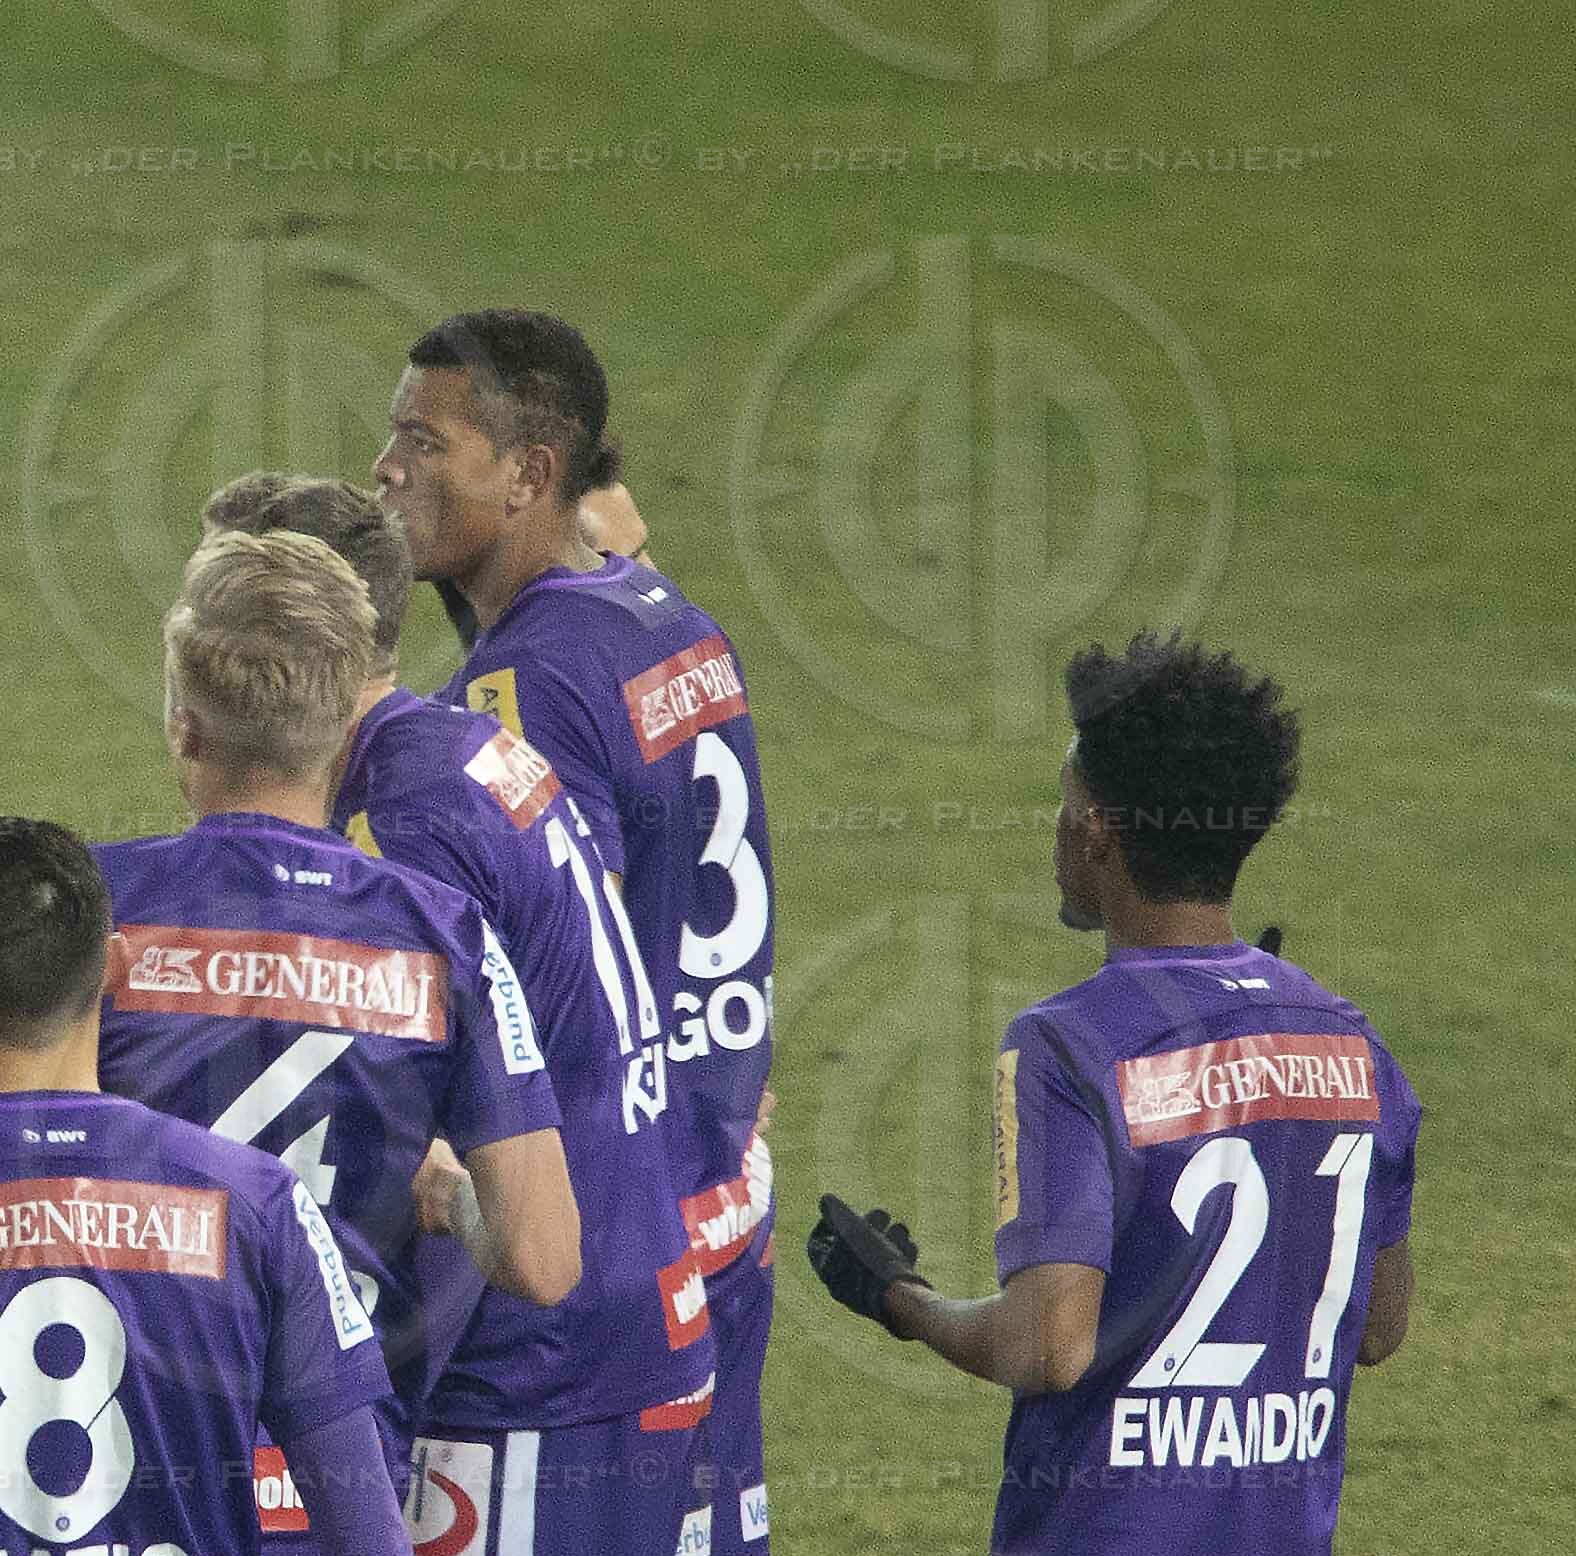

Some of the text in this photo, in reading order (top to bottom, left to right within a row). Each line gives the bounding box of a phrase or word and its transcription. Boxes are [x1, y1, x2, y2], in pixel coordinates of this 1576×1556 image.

[679, 731, 770, 980] 3
[205, 948, 434, 1028] GENERALI
[483, 950, 533, 1064] erbund
[1200, 1051, 1374, 1110] GENERALI
[298, 1196, 366, 1338] Verbund
[1128, 1132, 1374, 1388] 21
